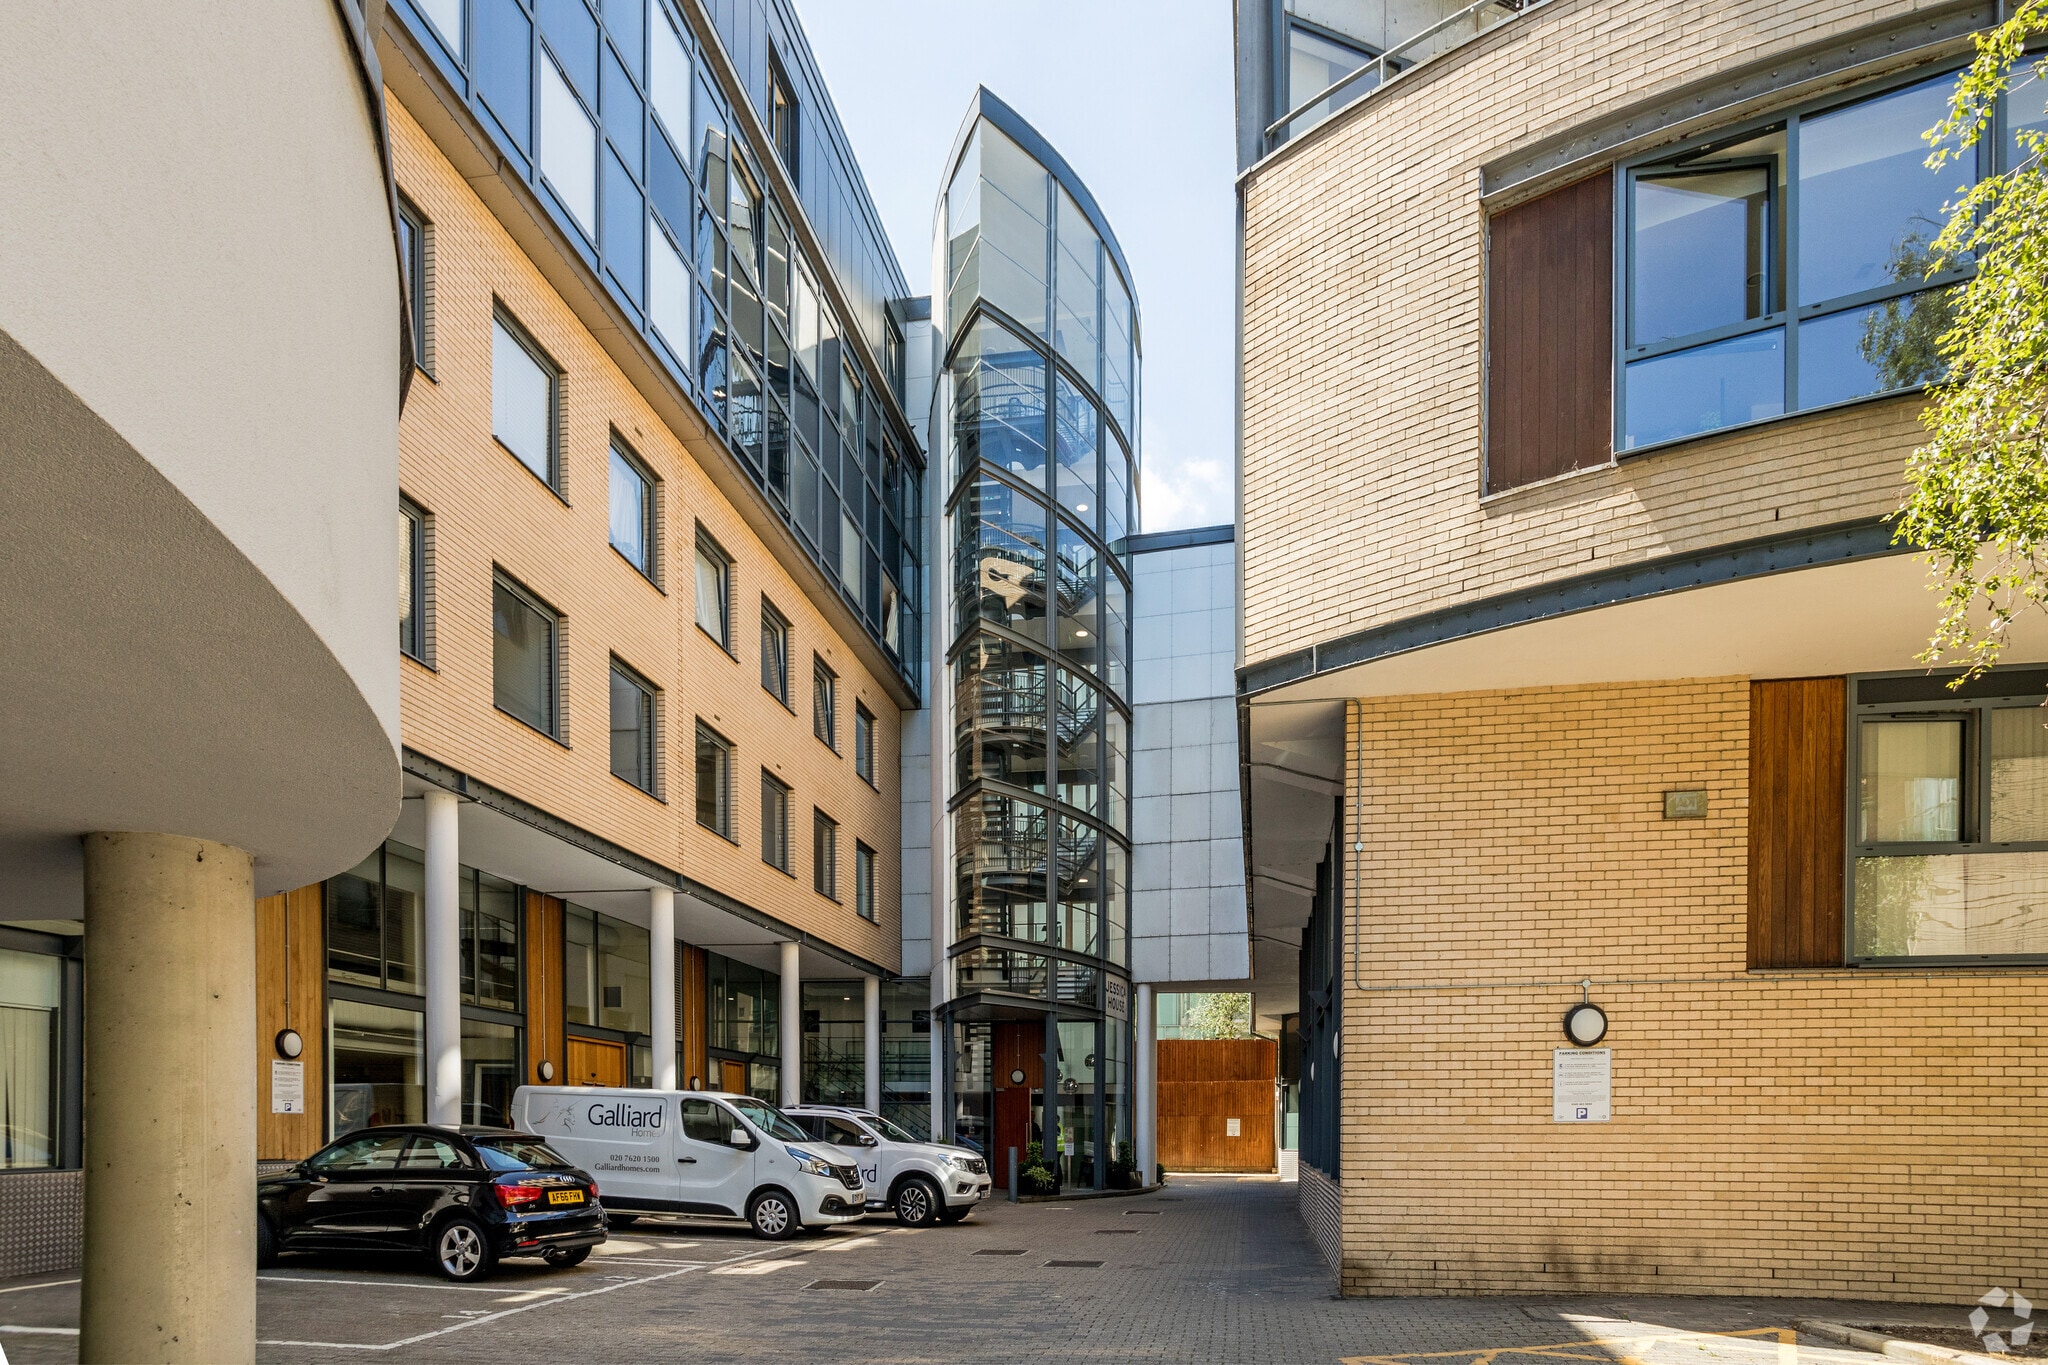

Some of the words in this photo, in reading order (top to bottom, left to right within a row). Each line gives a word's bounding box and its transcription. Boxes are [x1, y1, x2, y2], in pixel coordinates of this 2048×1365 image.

[1106, 981, 1126, 998] JESSICA
[1108, 996, 1125, 1013] HOUSE
[588, 1103, 662, 1128] Galliard
[631, 1128, 660, 1138] Homes
[610, 1154, 623, 1162] 020
[624, 1154, 641, 1162] 7620
[643, 1155, 660, 1163] 1500
[594, 1163, 660, 1173] Galliardhomes.com
[552, 1192, 569, 1202] AF66
